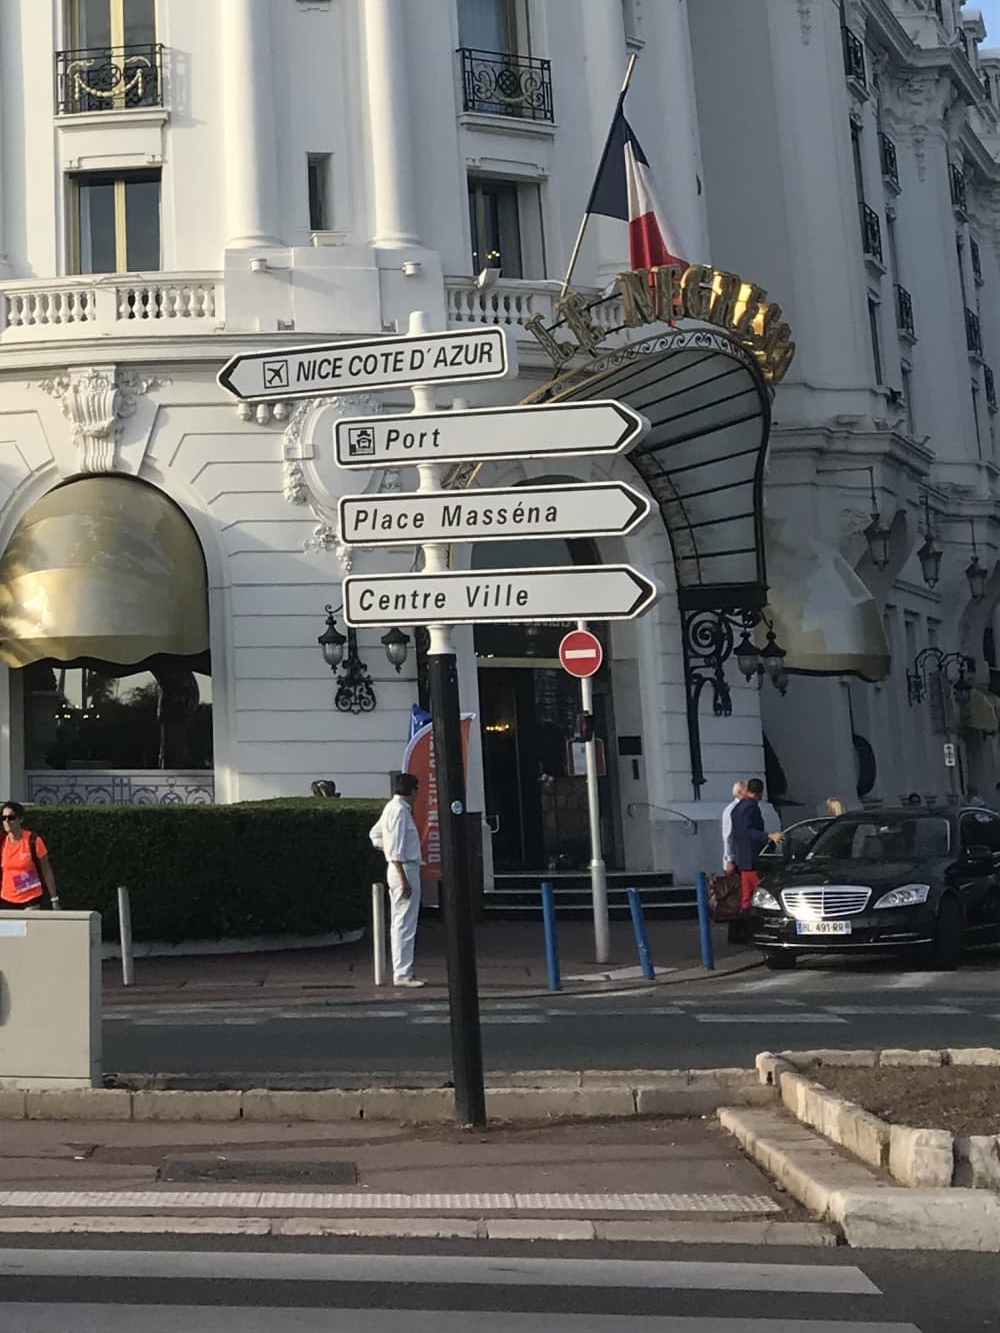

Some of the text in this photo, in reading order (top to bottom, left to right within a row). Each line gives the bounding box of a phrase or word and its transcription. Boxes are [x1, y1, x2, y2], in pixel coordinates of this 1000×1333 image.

[524, 291, 606, 366] LE
[296, 357, 343, 382] NICE
[348, 350, 405, 377] COTE
[385, 428, 440, 451] Port
[354, 501, 558, 531] Place Masséna
[359, 583, 529, 611] Centre Ville
